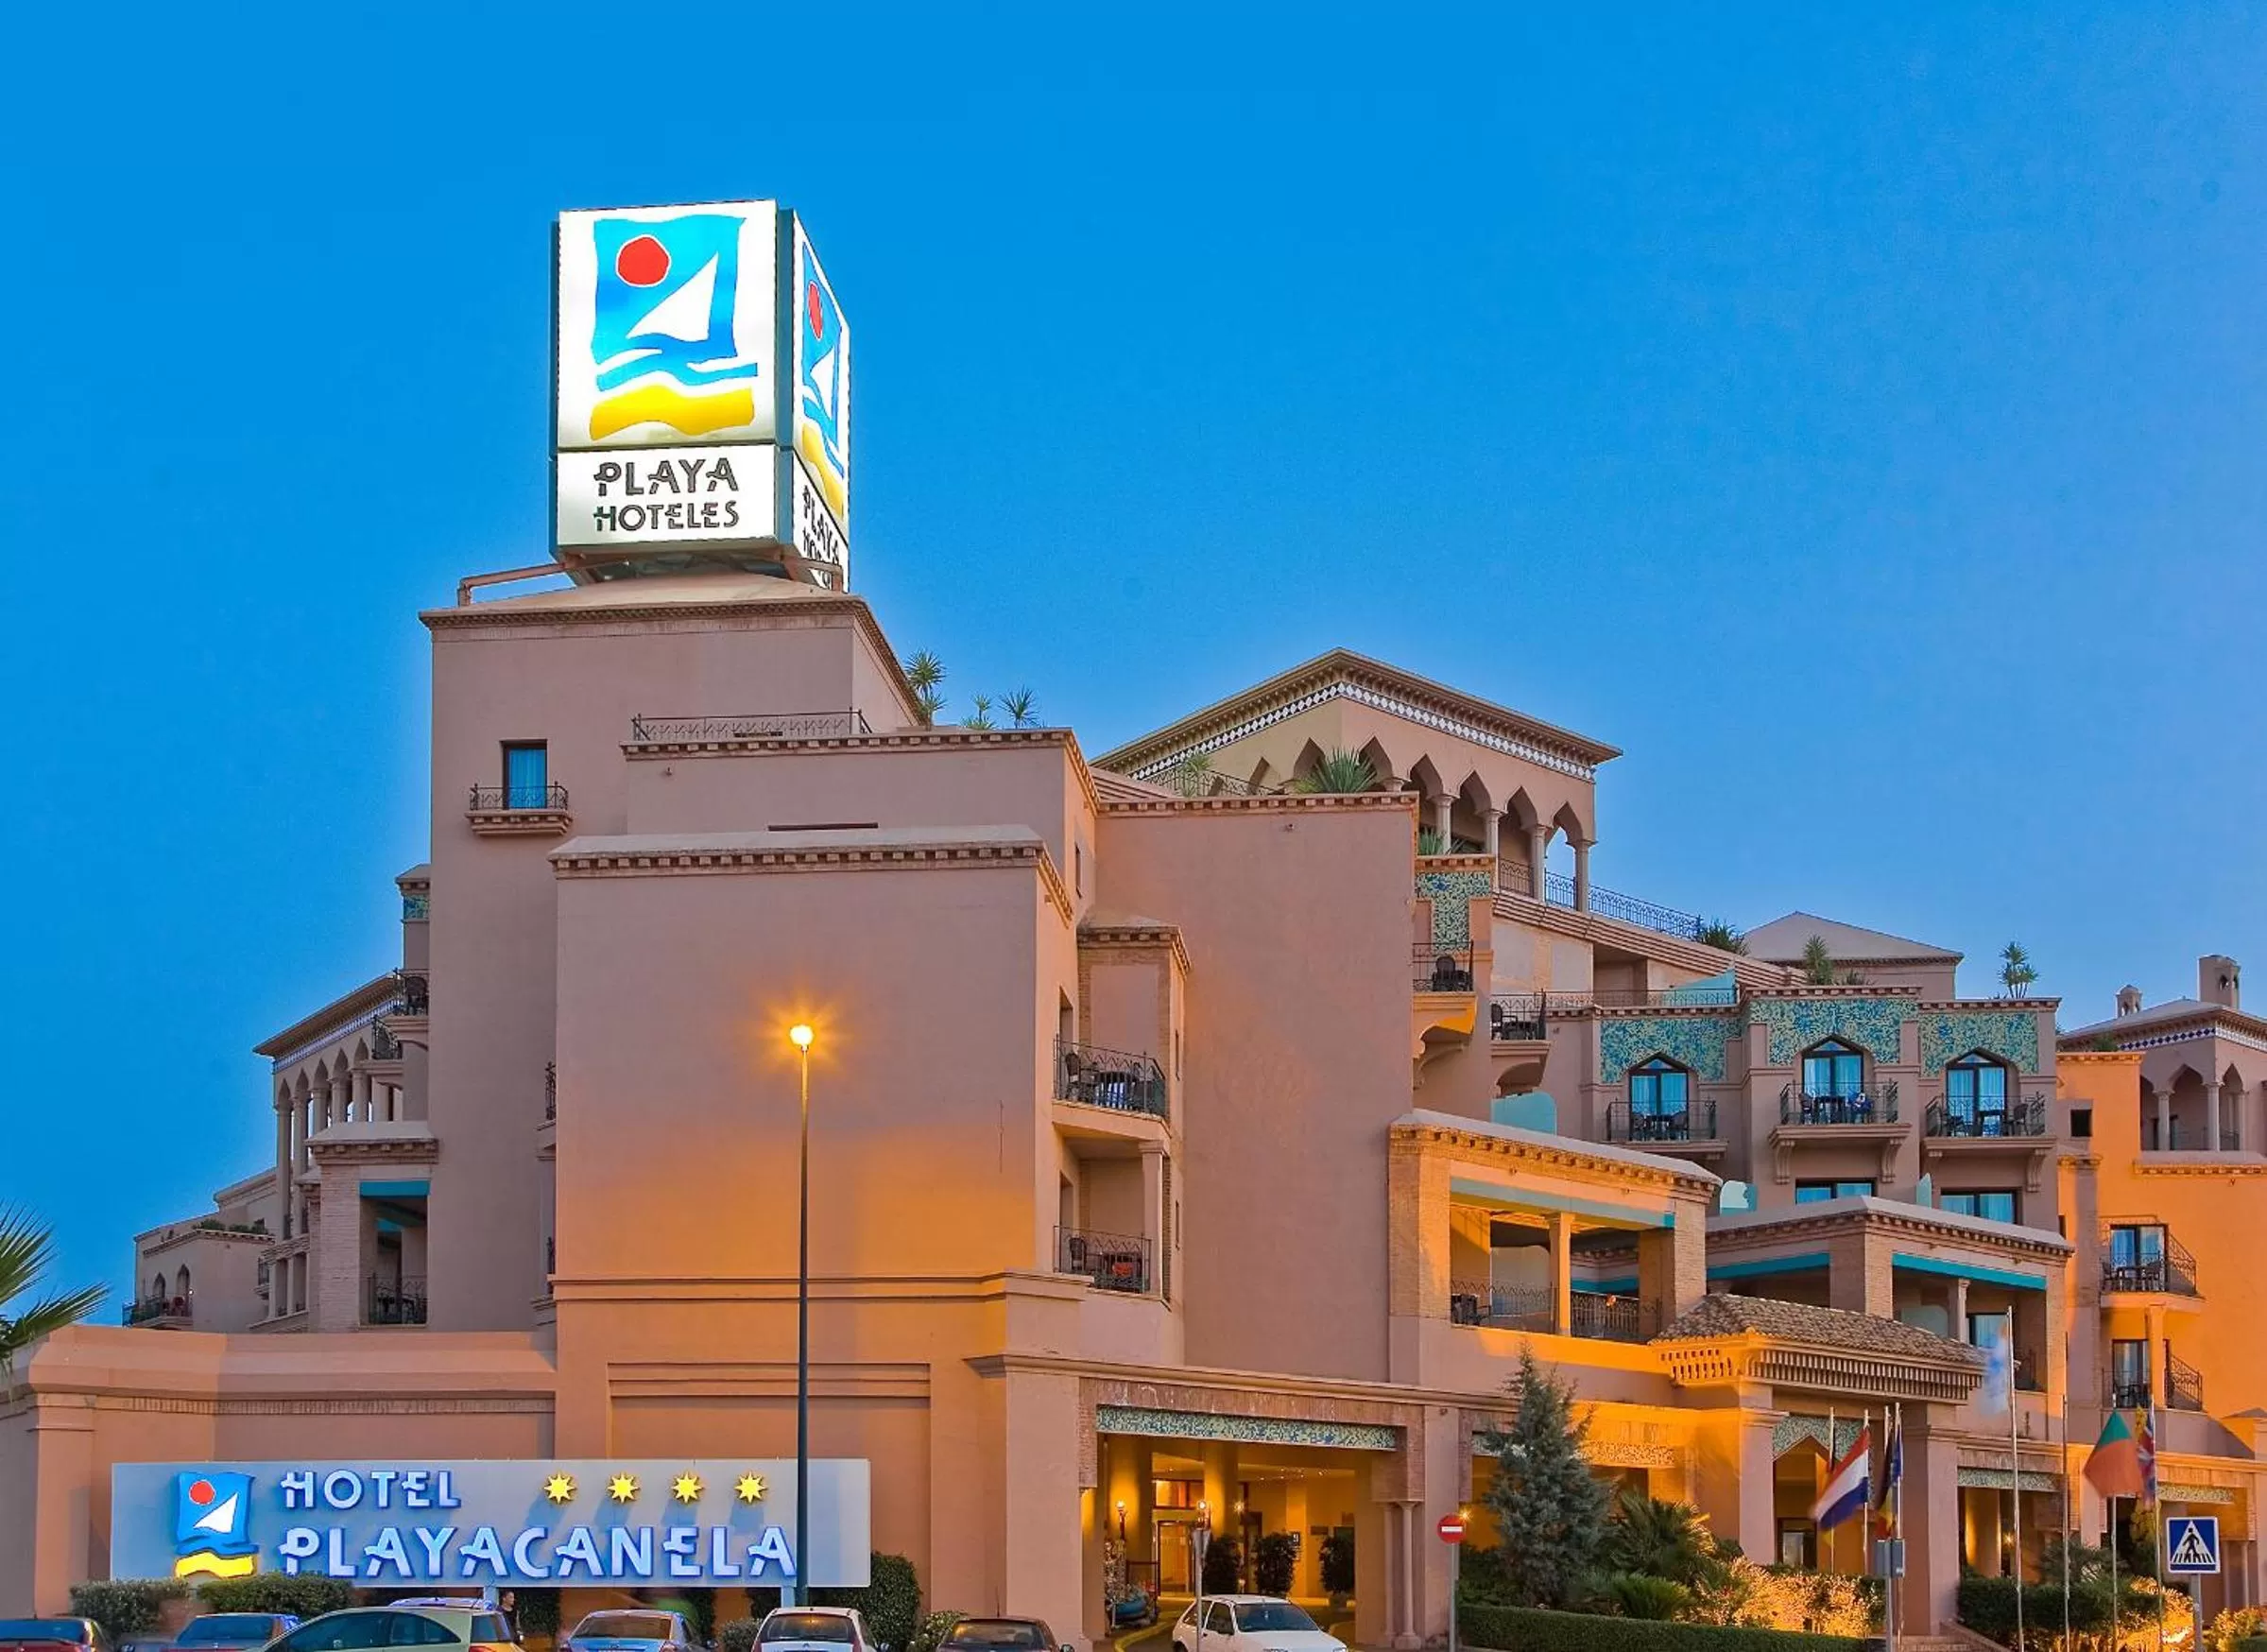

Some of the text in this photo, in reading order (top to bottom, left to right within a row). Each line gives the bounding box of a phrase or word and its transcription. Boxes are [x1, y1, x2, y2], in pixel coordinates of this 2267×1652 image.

[593, 457, 739, 497] PLAYA
[593, 500, 740, 532] HOTELES
[802, 485, 839, 565] PLAYA
[281, 1470, 462, 1509] HOTEL
[278, 1525, 798, 1578] PLAYACANELA
